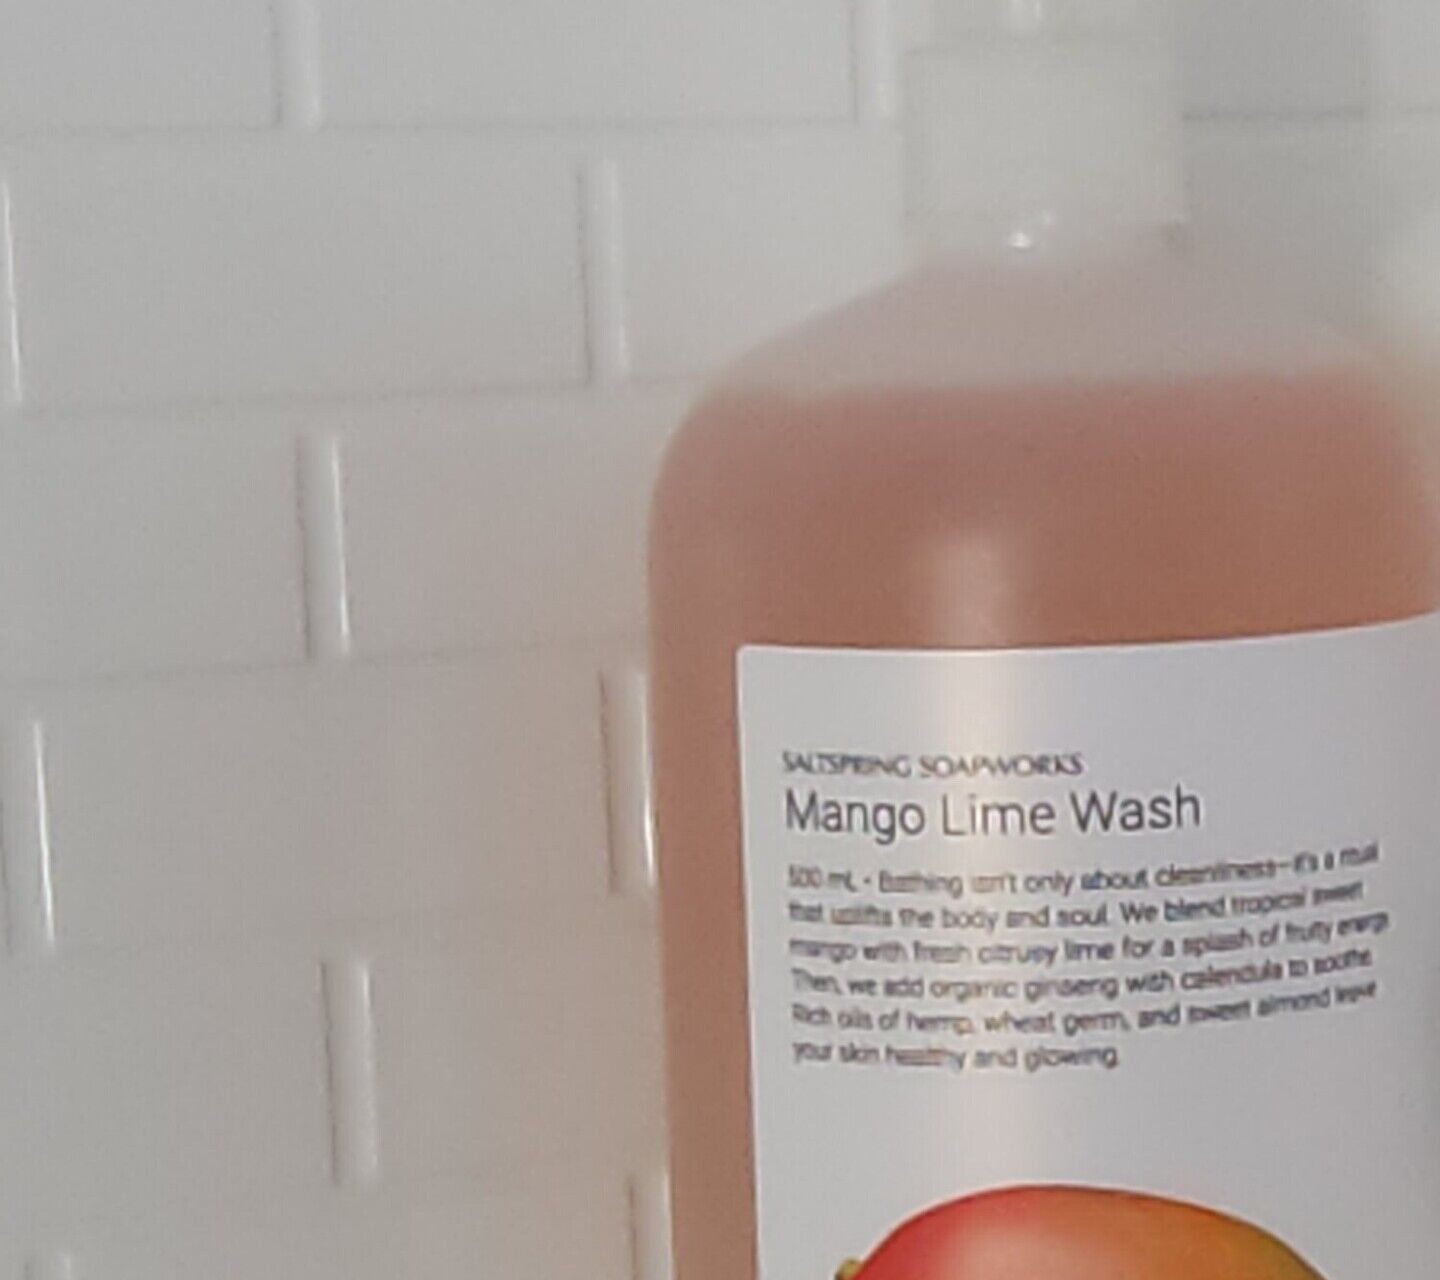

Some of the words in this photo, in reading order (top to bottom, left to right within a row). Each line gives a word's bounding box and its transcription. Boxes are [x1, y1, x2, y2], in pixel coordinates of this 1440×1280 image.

[783, 751, 911, 777] SALTSPRING
[919, 752, 1085, 777] SOAPWORKS
[786, 788, 926, 845] Mango
[942, 792, 1056, 836] Lime
[1070, 784, 1200, 832] Wash
[1024, 871, 1073, 897] only
[1081, 868, 1148, 890] about
[899, 906, 932, 928] the
[942, 907, 999, 933] body
[1006, 905, 1049, 928] and
[1120, 902, 1158, 923] We
[1164, 897, 1225, 921] blend
[1063, 938, 1114, 962] lime
[1122, 936, 1153, 958] for
[1161, 939, 1175, 957] a
[1259, 923, 1280, 948] of
[847, 979, 877, 996] we
[883, 978, 924, 998] add
[929, 979, 1018, 1003] organic
[1024, 977, 1119, 1003] ginseng
[1125, 971, 1174, 993] with
[1289, 958, 1309, 977] to
[879, 1008, 900, 1031] of
[983, 1011, 1056, 1033] wheat
[1138, 1004, 1182, 1029] and
[973, 1048, 1018, 1068] and
